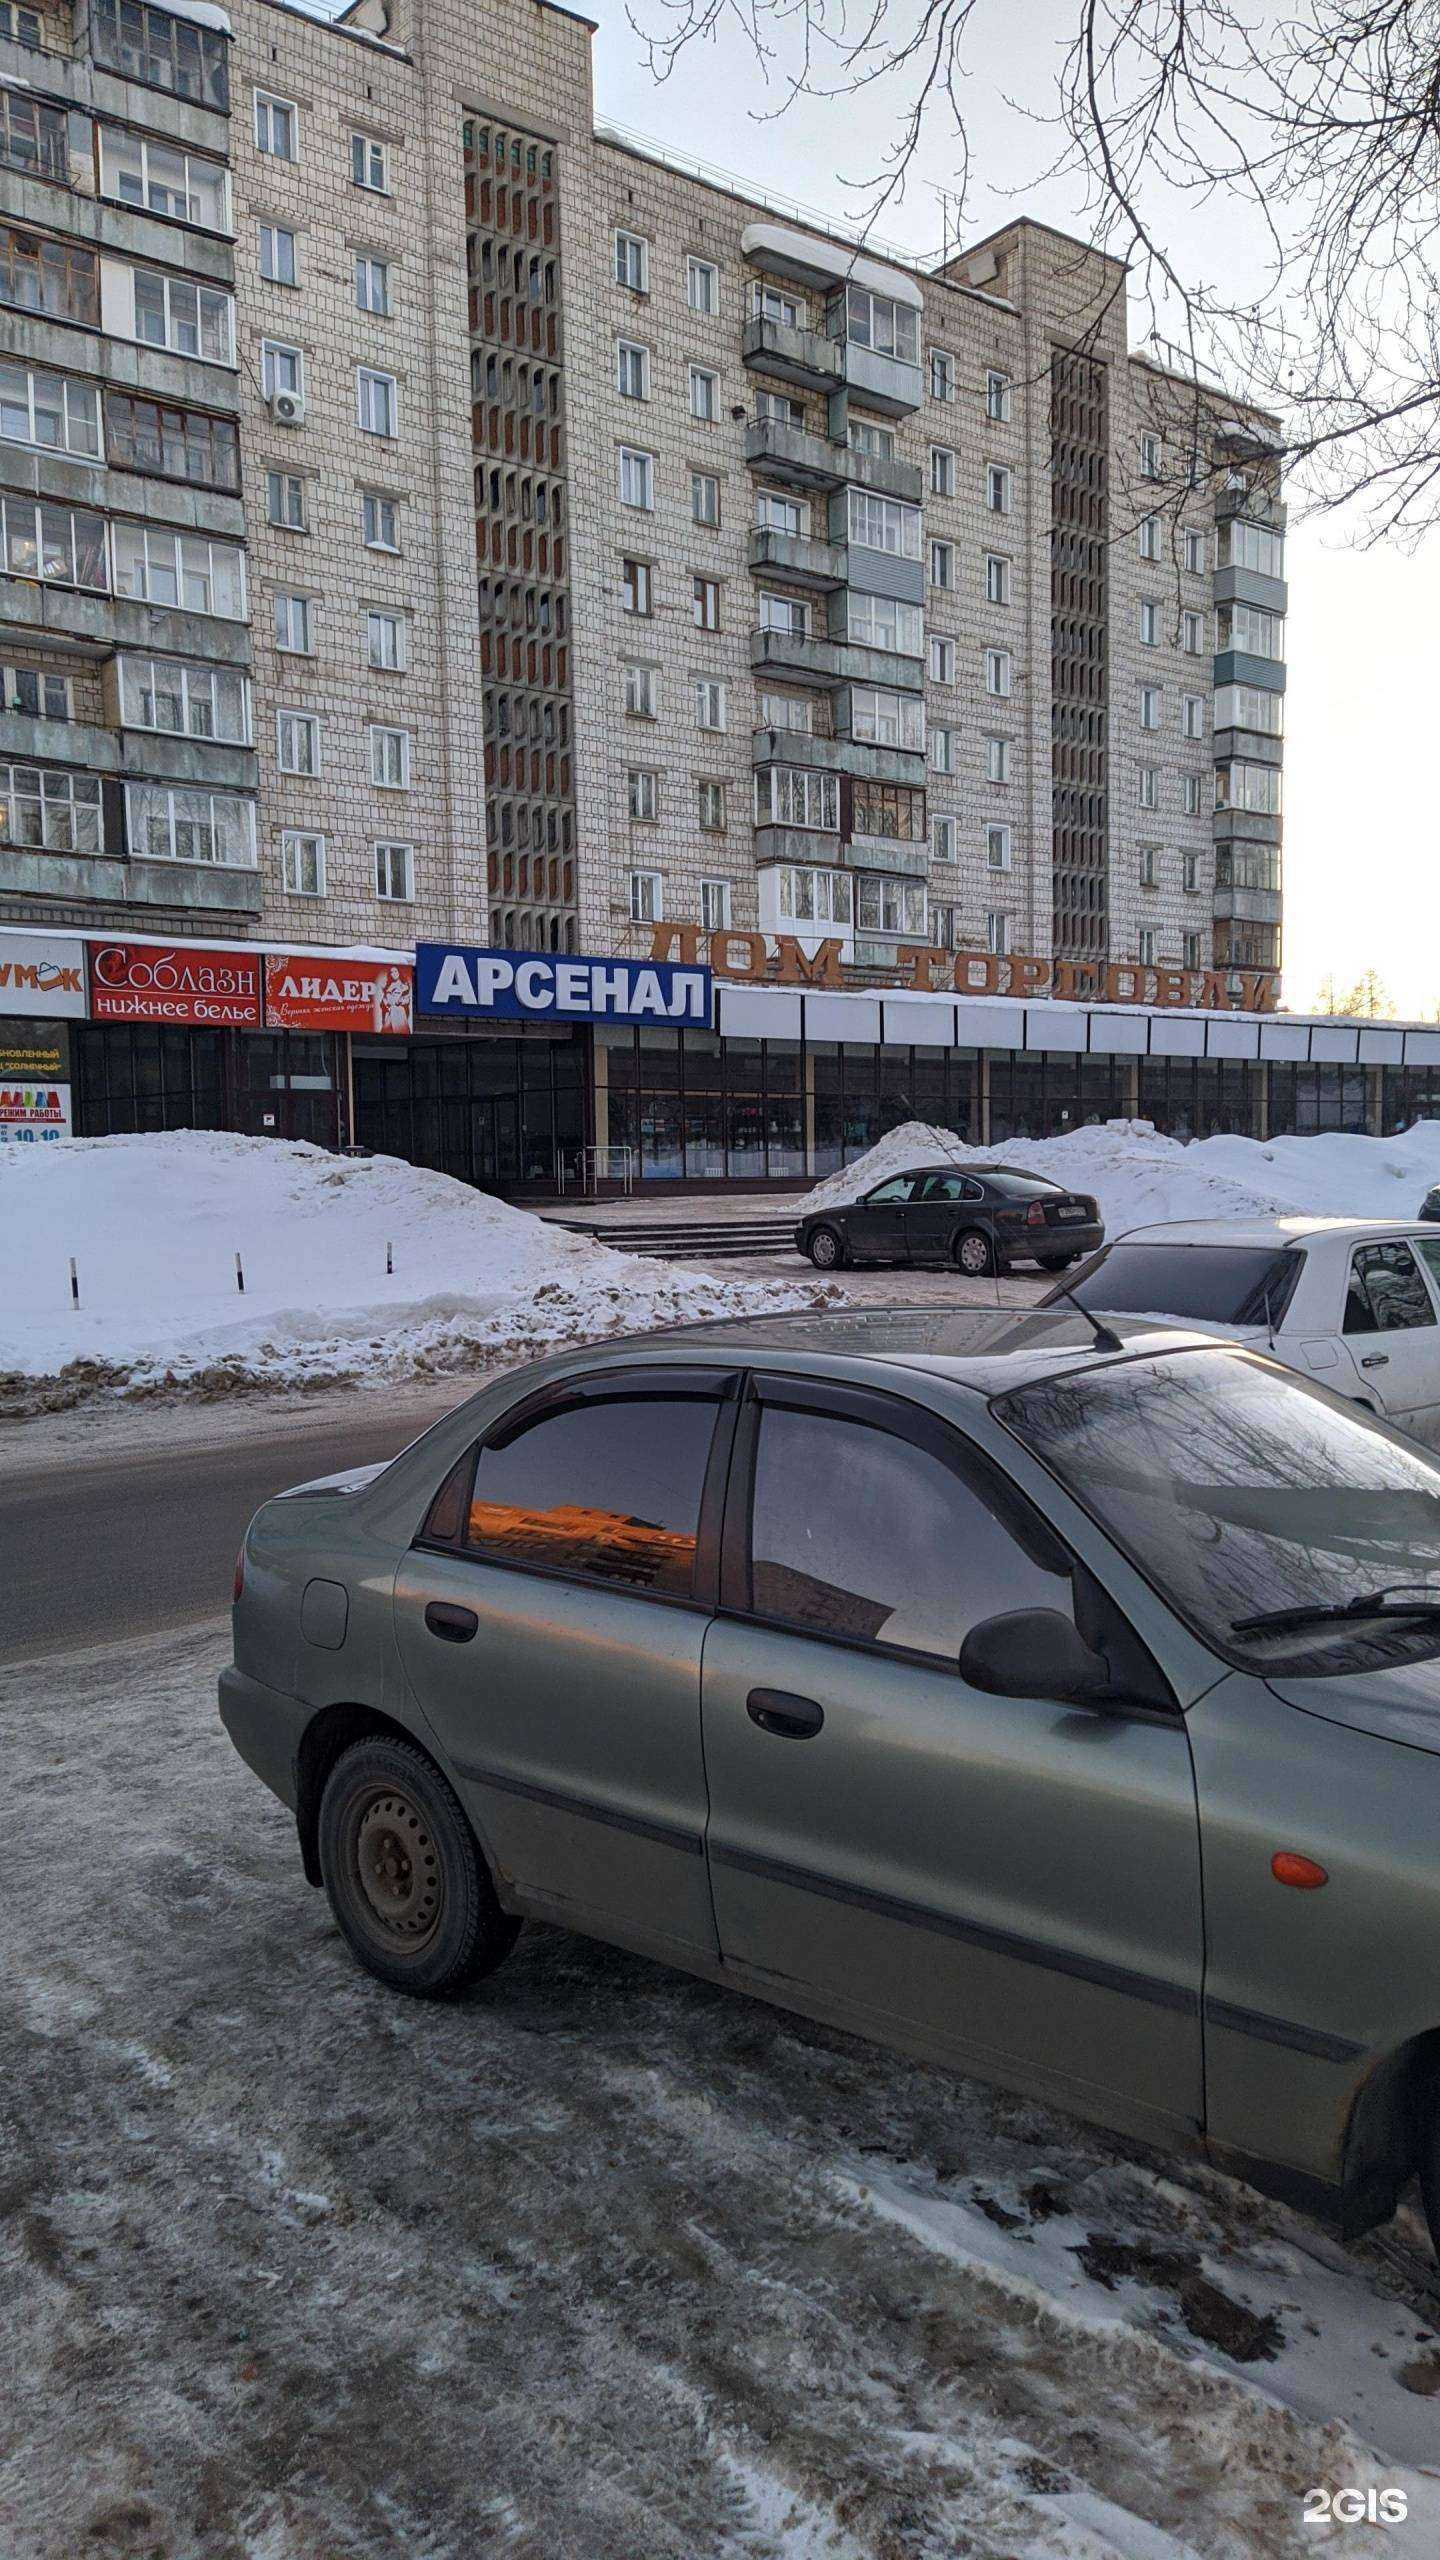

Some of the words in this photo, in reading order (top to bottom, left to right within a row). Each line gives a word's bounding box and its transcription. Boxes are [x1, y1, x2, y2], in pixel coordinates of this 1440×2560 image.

[95, 948, 255, 995] Соблазн
[278, 975, 378, 1002] ЛИДЕР
[432, 955, 704, 1018] АРСЕНАЛ
[647, 922, 844, 986] ДОМ
[897, 945, 1281, 1012] ТОРГОВЛИ
[97, 995, 189, 1017] нижнее
[194, 1000, 257, 1021] белье
